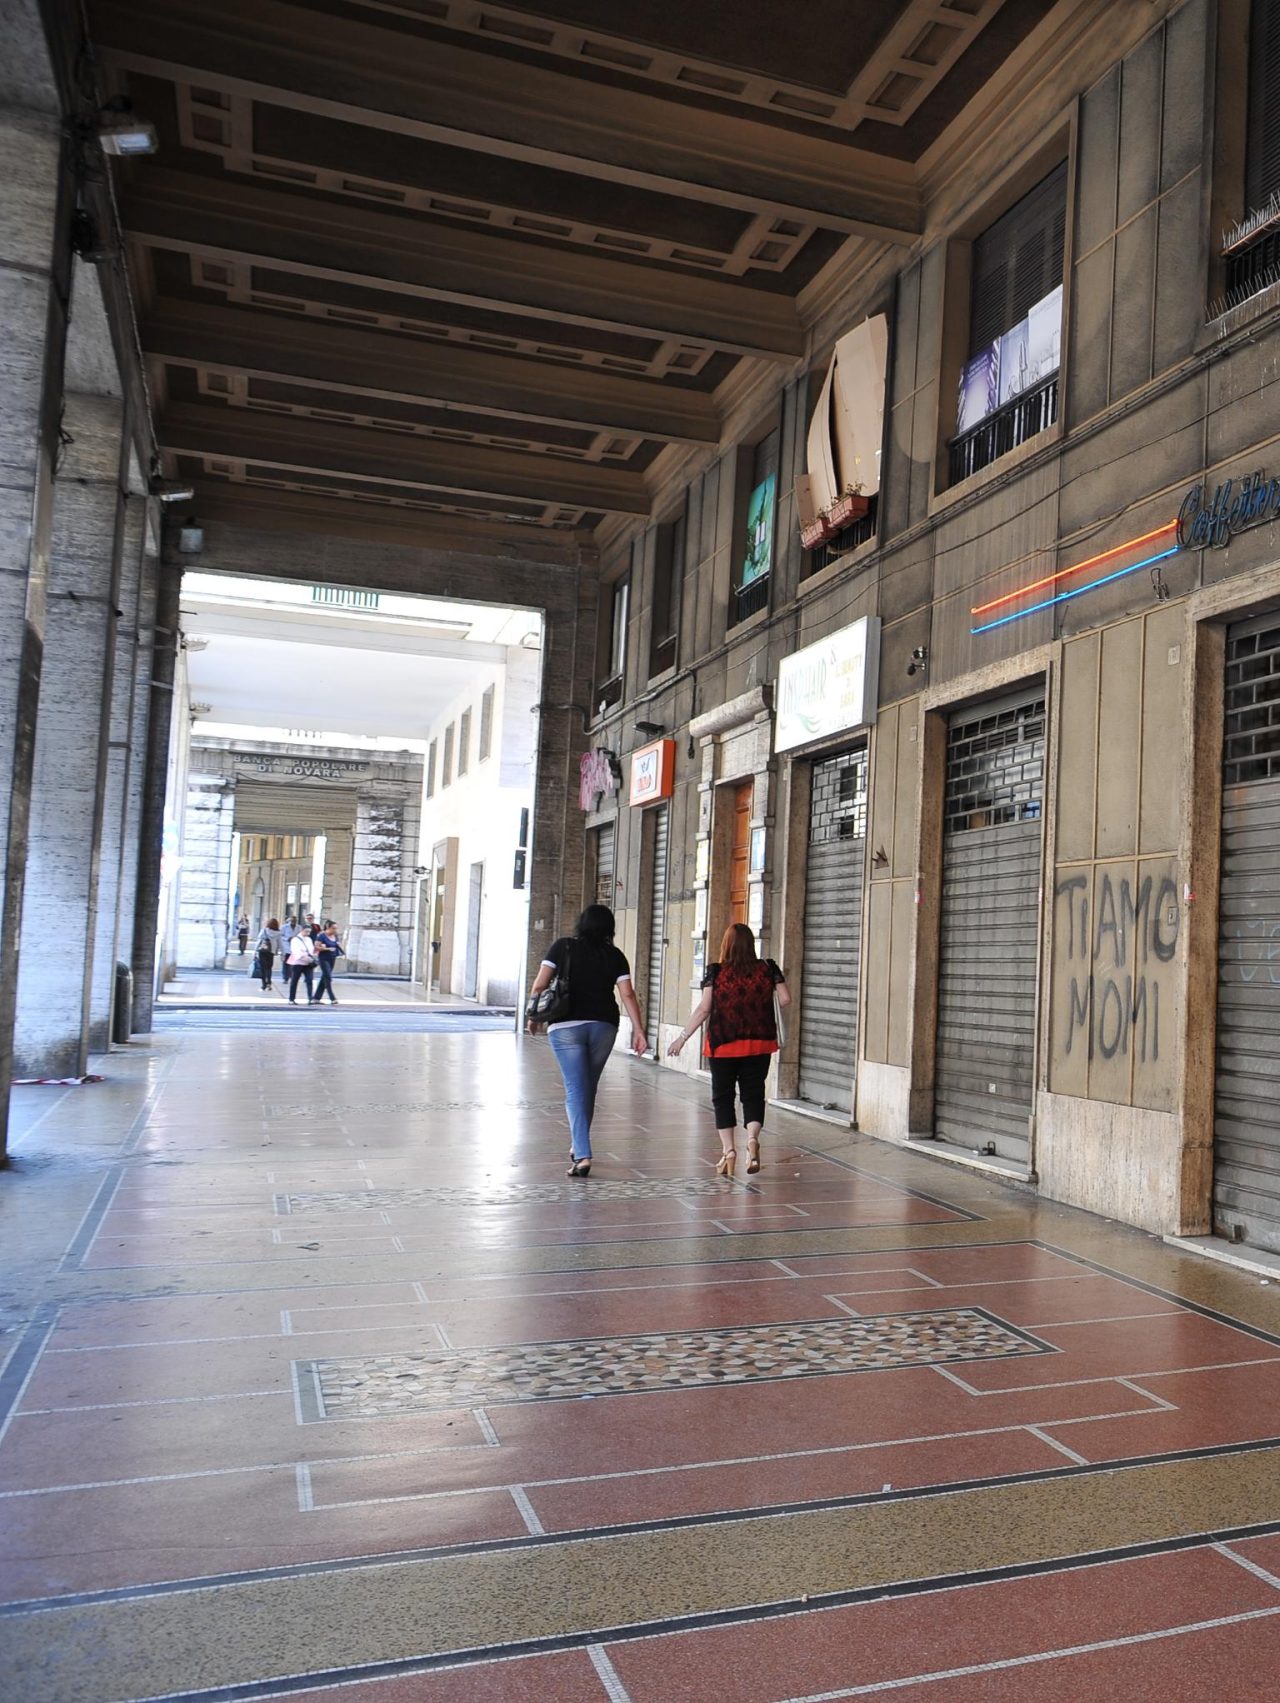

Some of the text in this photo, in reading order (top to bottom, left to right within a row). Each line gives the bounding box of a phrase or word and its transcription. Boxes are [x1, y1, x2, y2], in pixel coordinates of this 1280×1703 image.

[233, 754, 367, 772] BANCA POPOLARE
[257, 764, 342, 777] DI NOVARA
